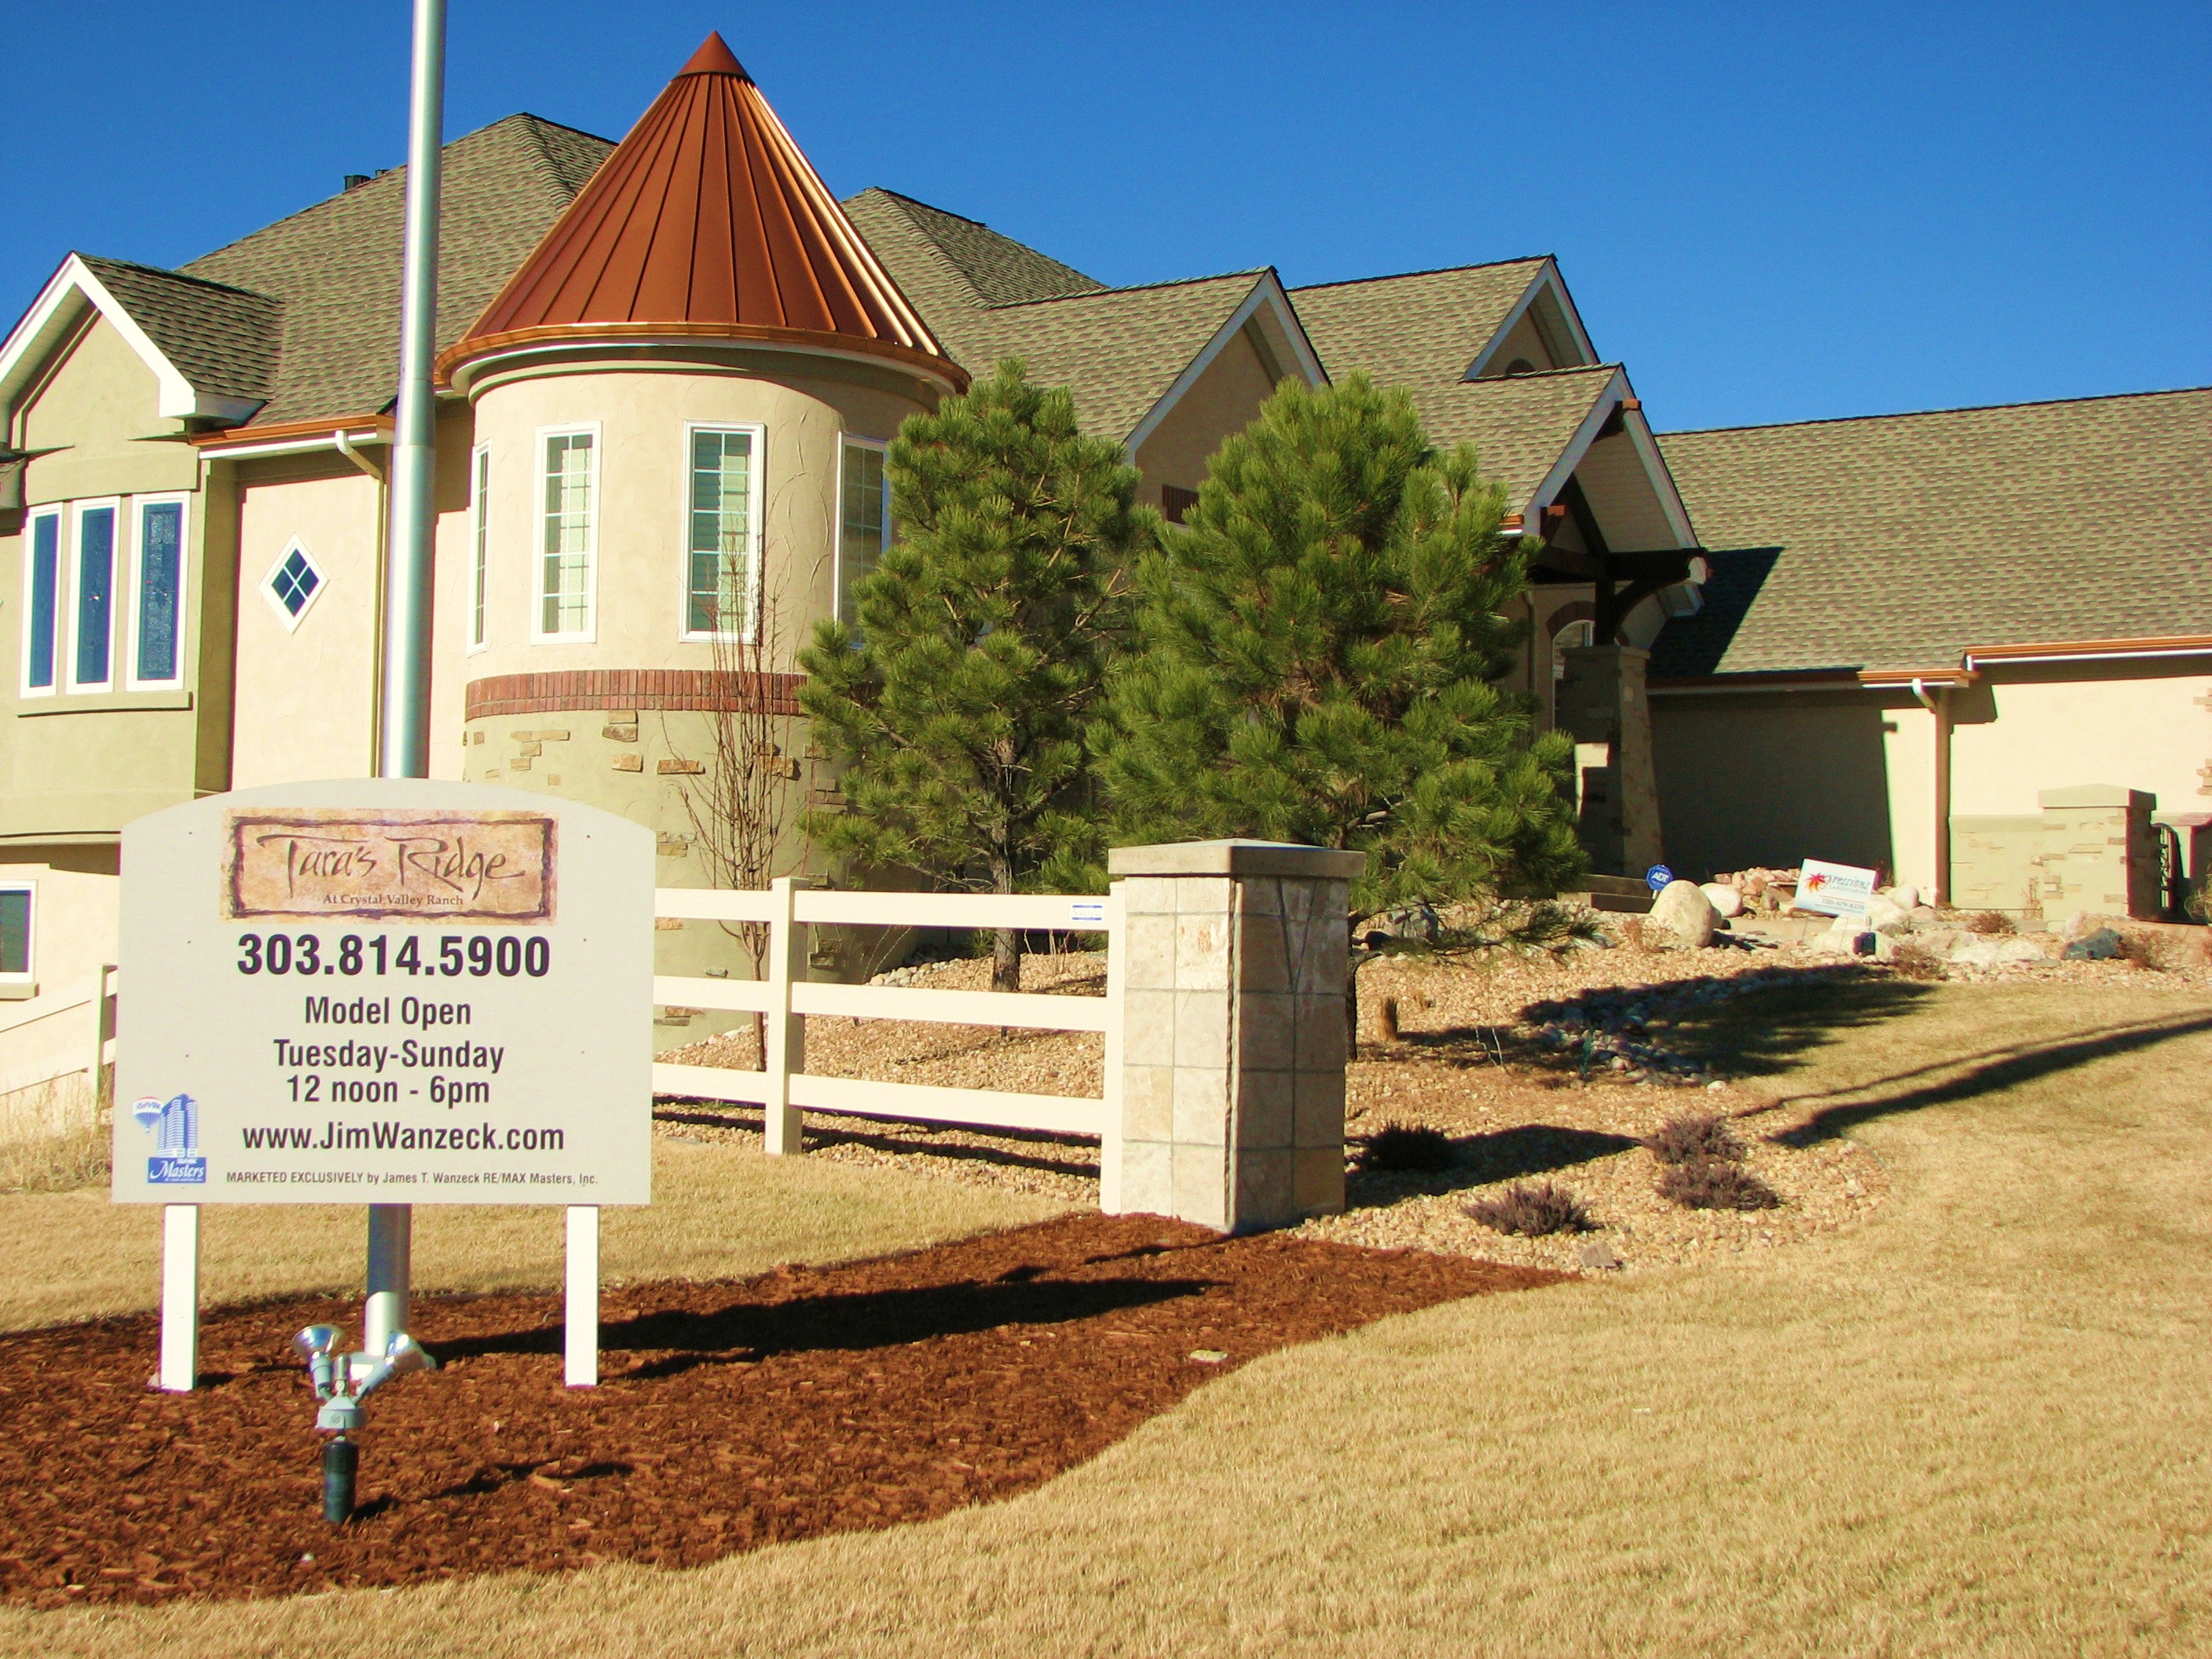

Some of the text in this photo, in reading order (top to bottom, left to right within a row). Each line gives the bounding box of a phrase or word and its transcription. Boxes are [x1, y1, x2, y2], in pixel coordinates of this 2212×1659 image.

[257, 834, 526, 900] Tara's Ridge
[1651, 872, 1669, 882] ADT
[323, 894, 463, 907] At Crystal Valley Ranch
[236, 932, 551, 978] 303.814.5900
[305, 995, 471, 1031] Model Open
[273, 1038, 505, 1075] Tuesday-Sunday
[286, 1074, 320, 1103] 12
[331, 1081, 398, 1104] noon
[430, 1075, 490, 1110] 6pm
[242, 1121, 564, 1151] www.JimWanzeck.com
[226, 1171, 598, 1185] MARKETED EXCLUSIVELY by James T. Wanzeck RE/MAX Masters, Inc.
